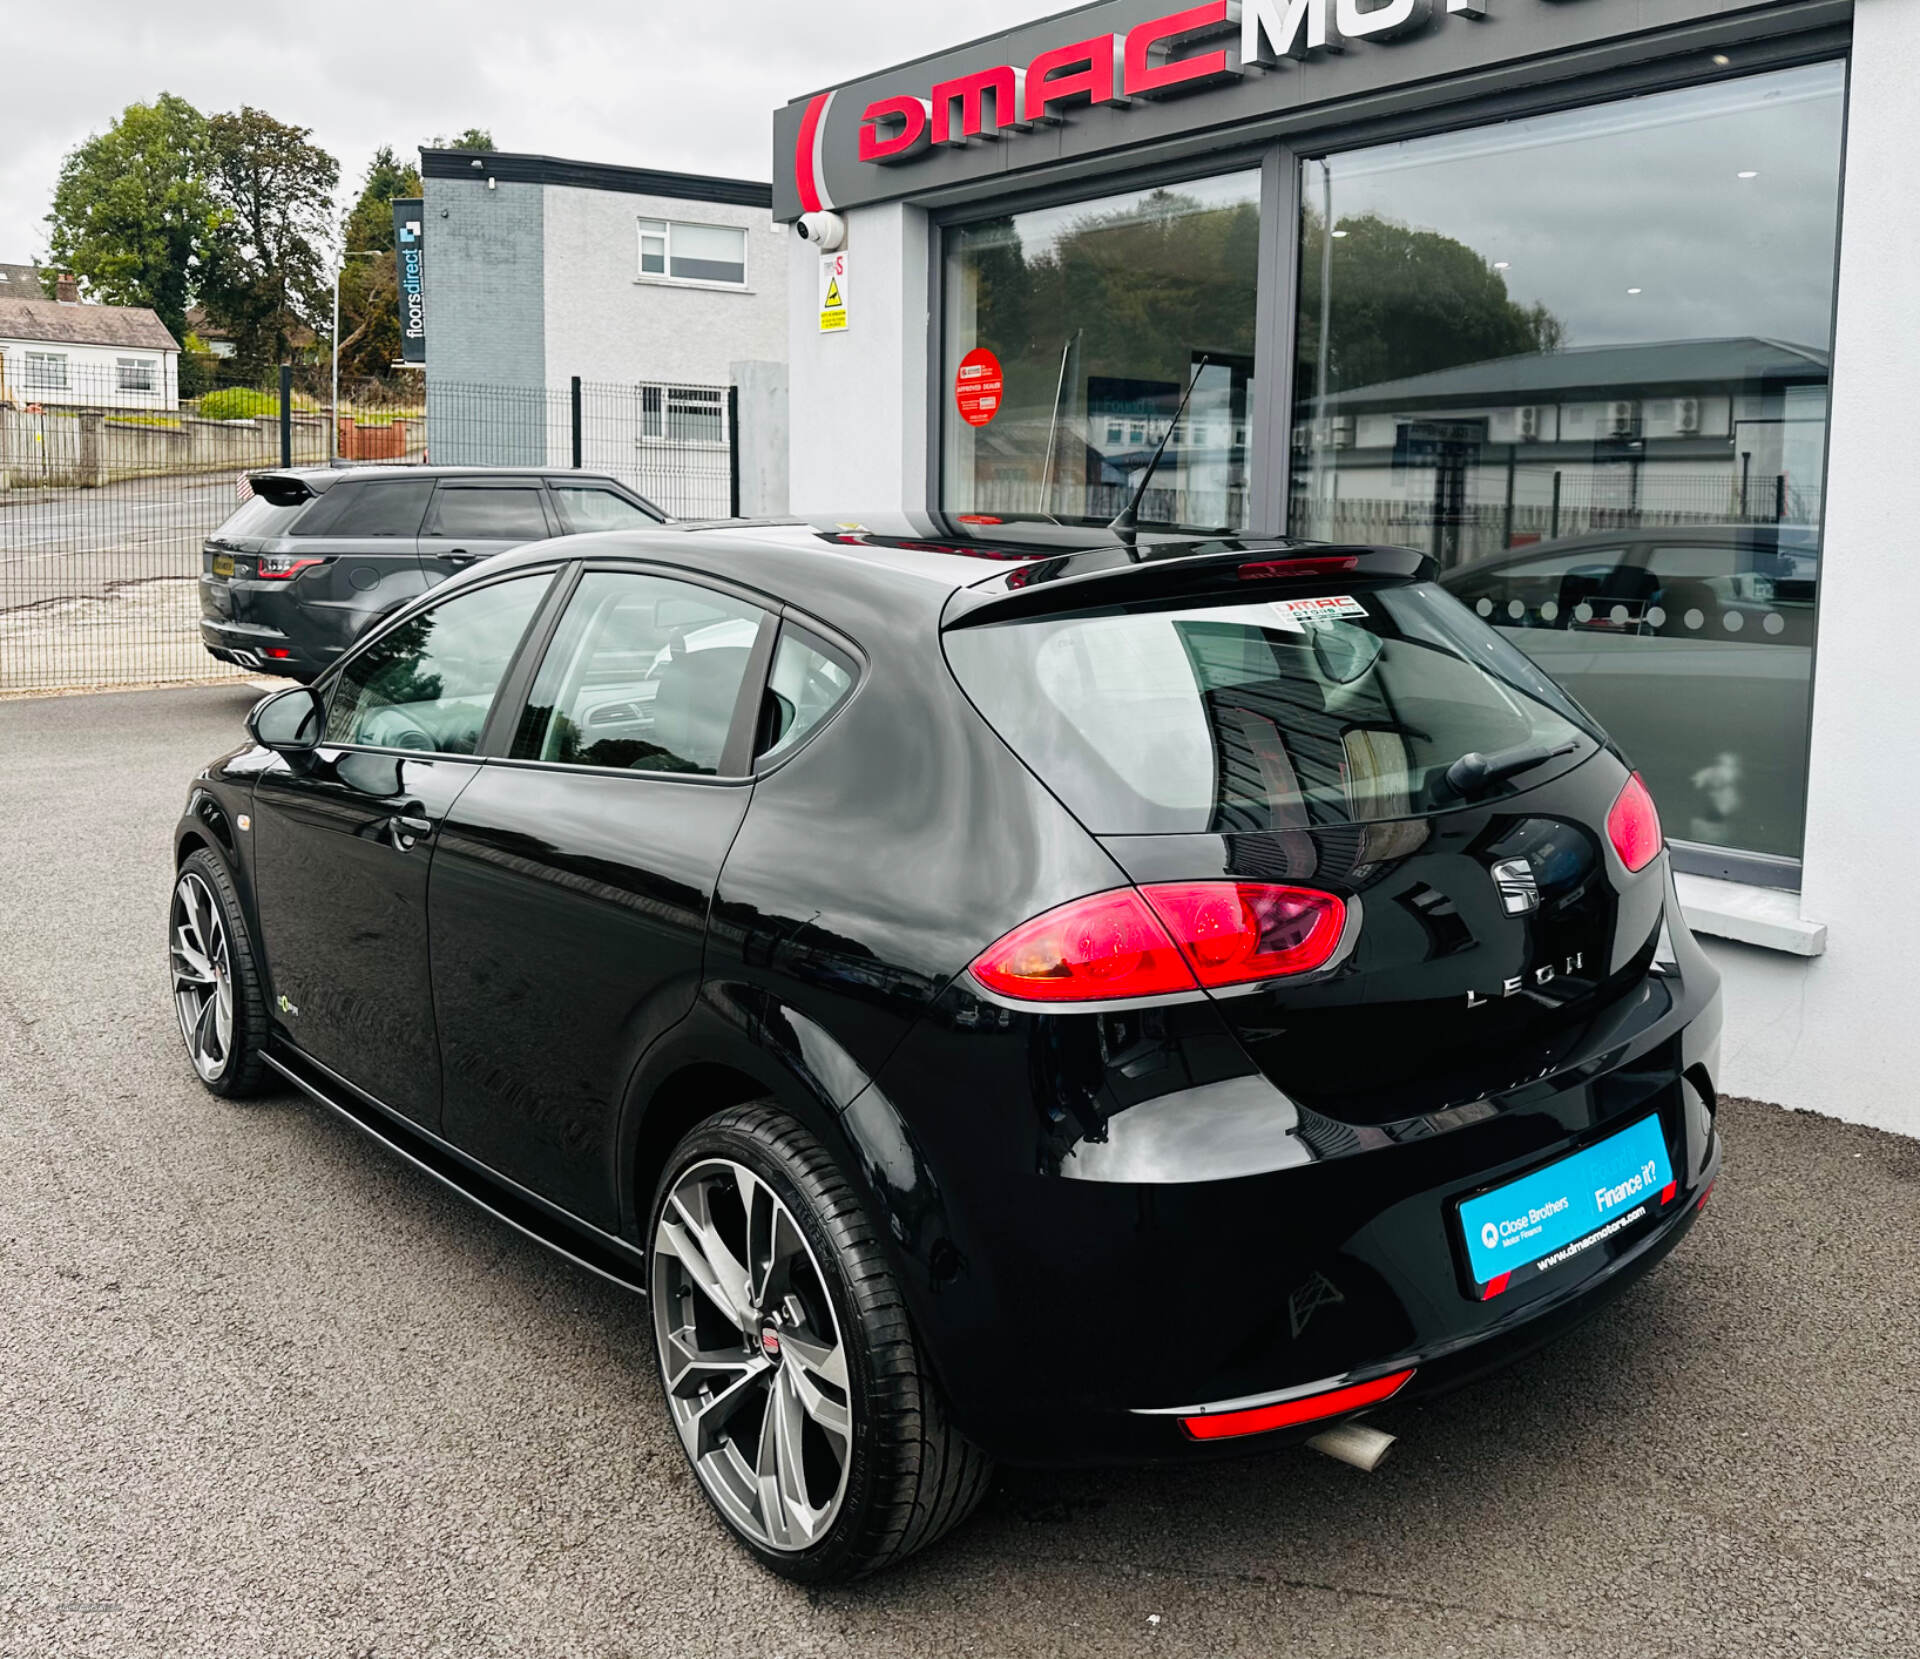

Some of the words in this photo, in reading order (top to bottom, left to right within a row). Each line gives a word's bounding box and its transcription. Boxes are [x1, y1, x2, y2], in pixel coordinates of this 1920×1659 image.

[858, 0, 1228, 163] DMAC
[401, 248, 424, 339] floorsdirect
[1467, 952, 1583, 1009] LEON
[1594, 1173, 1642, 1213] Finance
[1641, 1159, 1657, 1185] it?
[1499, 1216, 1529, 1237] Close
[1528, 1196, 1569, 1225] Brothers
[1502, 1236, 1520, 1248] Motor
[1520, 1225, 1543, 1240] Finance
[1536, 1206, 1646, 1272] www.dmacmotors.com
